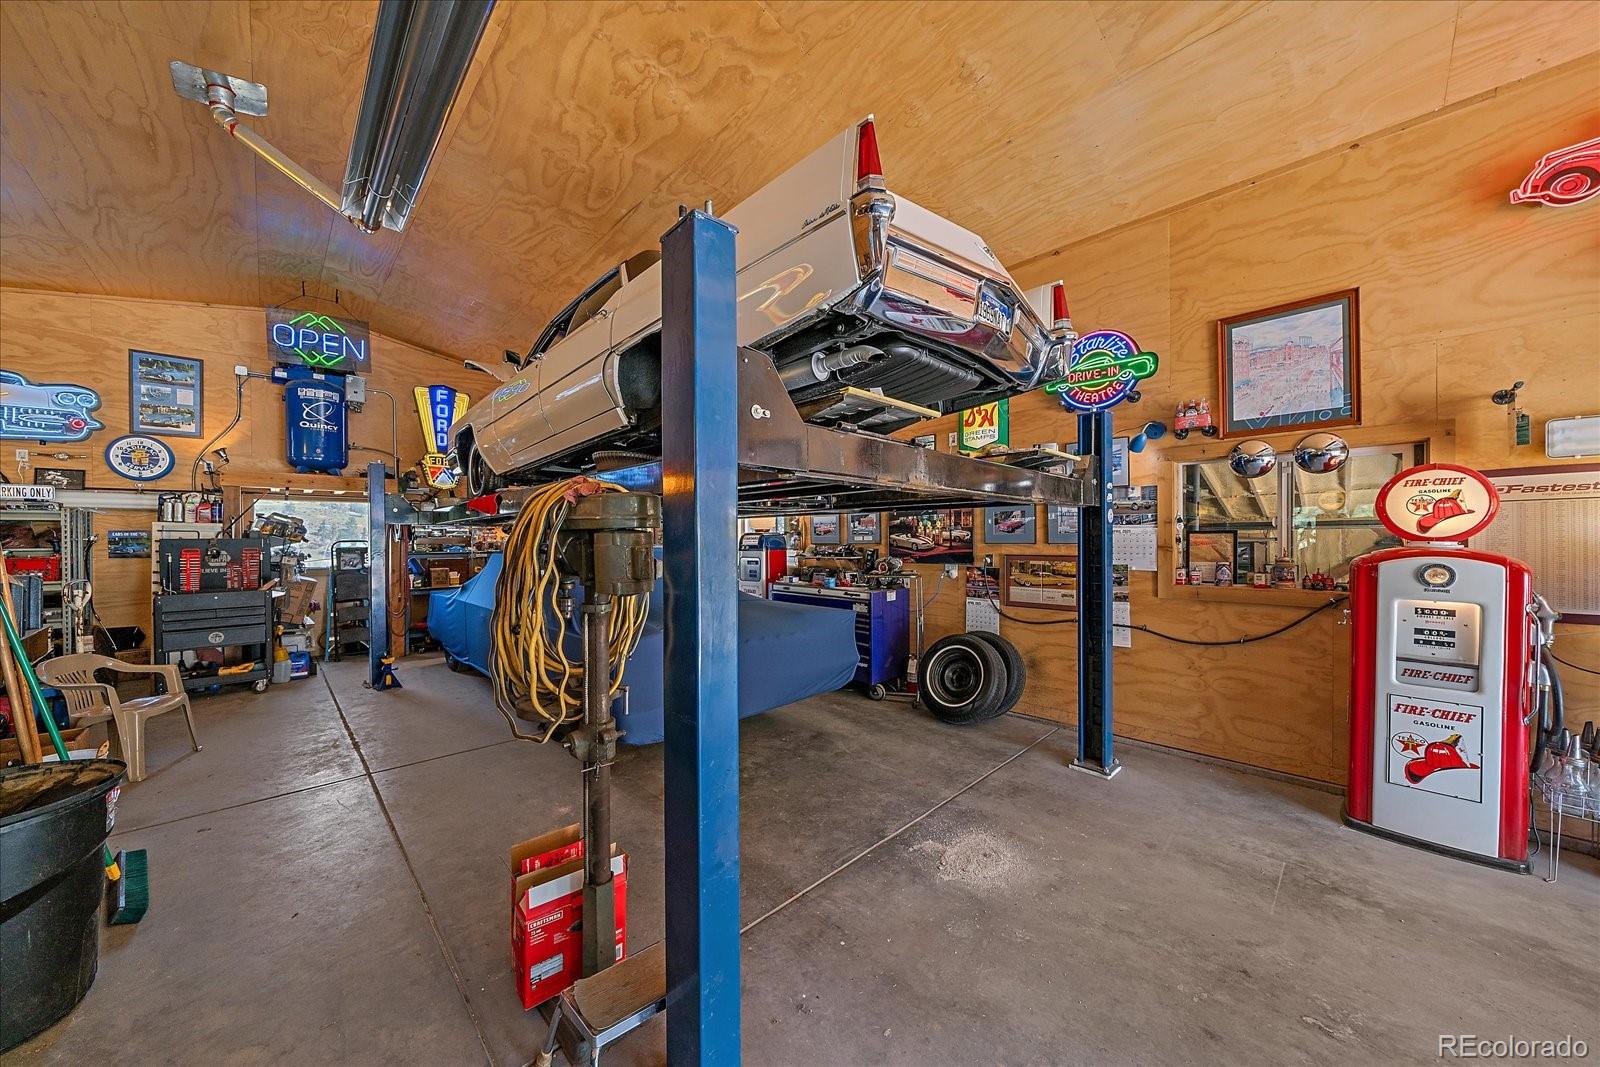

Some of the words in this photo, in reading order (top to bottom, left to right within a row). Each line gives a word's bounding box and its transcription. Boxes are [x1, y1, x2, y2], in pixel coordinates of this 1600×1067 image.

[273, 323, 365, 361] OPEN
[1068, 365, 1120, 384] DRIVE-IN
[1069, 380, 1125, 403] THEATRE
[436, 389, 449, 447] FORD
[299, 420, 339, 431] Quincy
[965, 433, 996, 443] STAMPS
[126, 462, 155, 471] SERVICE
[429, 457, 449, 465] FOR
[1403, 476, 1467, 488] FIRE-CHIEF
[1504, 482, 1600, 494] Fastest
[1, 487, 27, 497] RKING
[30, 487, 51, 498] ONLY
[1401, 667, 1475, 685] FIRE-CHIEF
[1393, 702, 1477, 724] FIRE-CHIEF
[1413, 719, 1456, 731] GASOLINE
[529, 911, 562, 929] CRAFTSMAN
